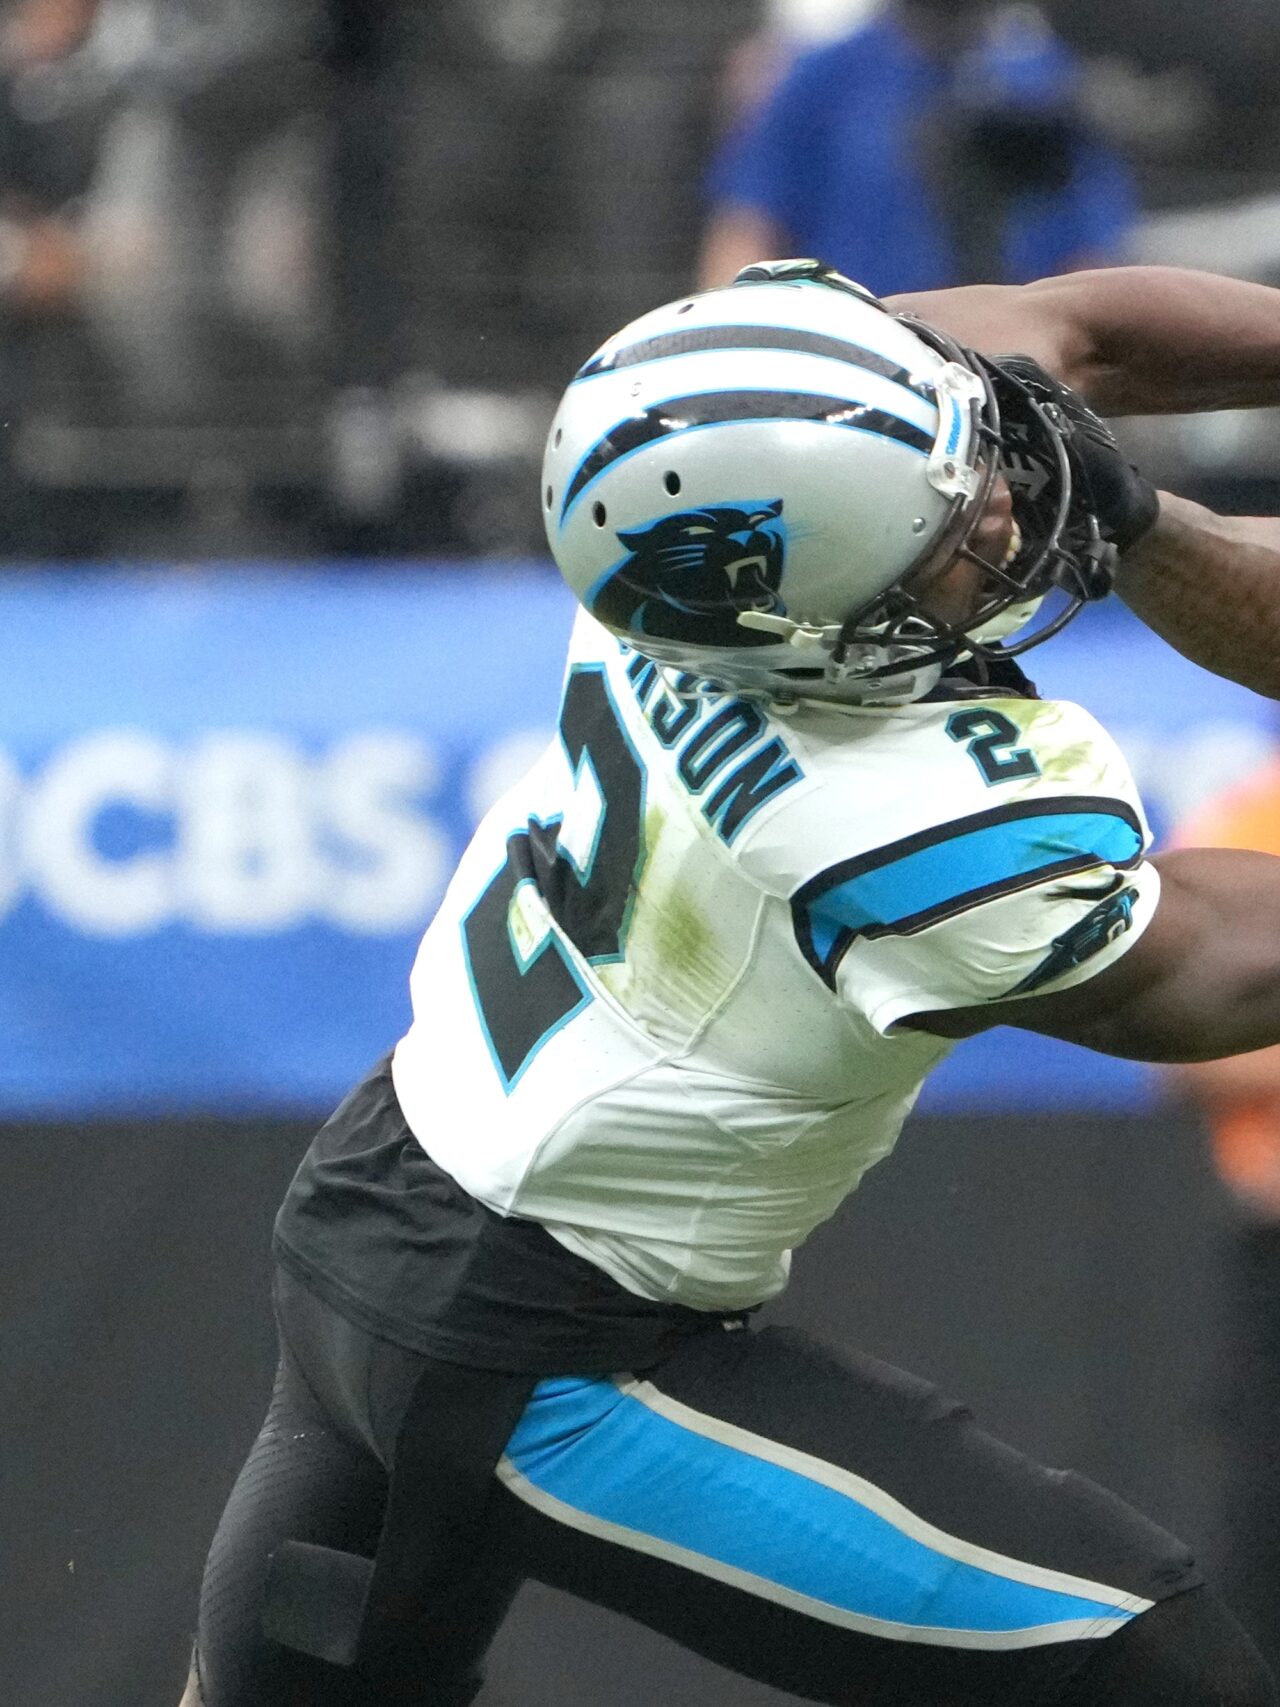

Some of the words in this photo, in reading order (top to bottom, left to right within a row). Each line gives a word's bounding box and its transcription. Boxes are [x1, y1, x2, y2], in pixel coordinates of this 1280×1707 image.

[30, 732, 450, 936] CBS
[945, 706, 1042, 788] 2
[459, 661, 648, 1097] 2
